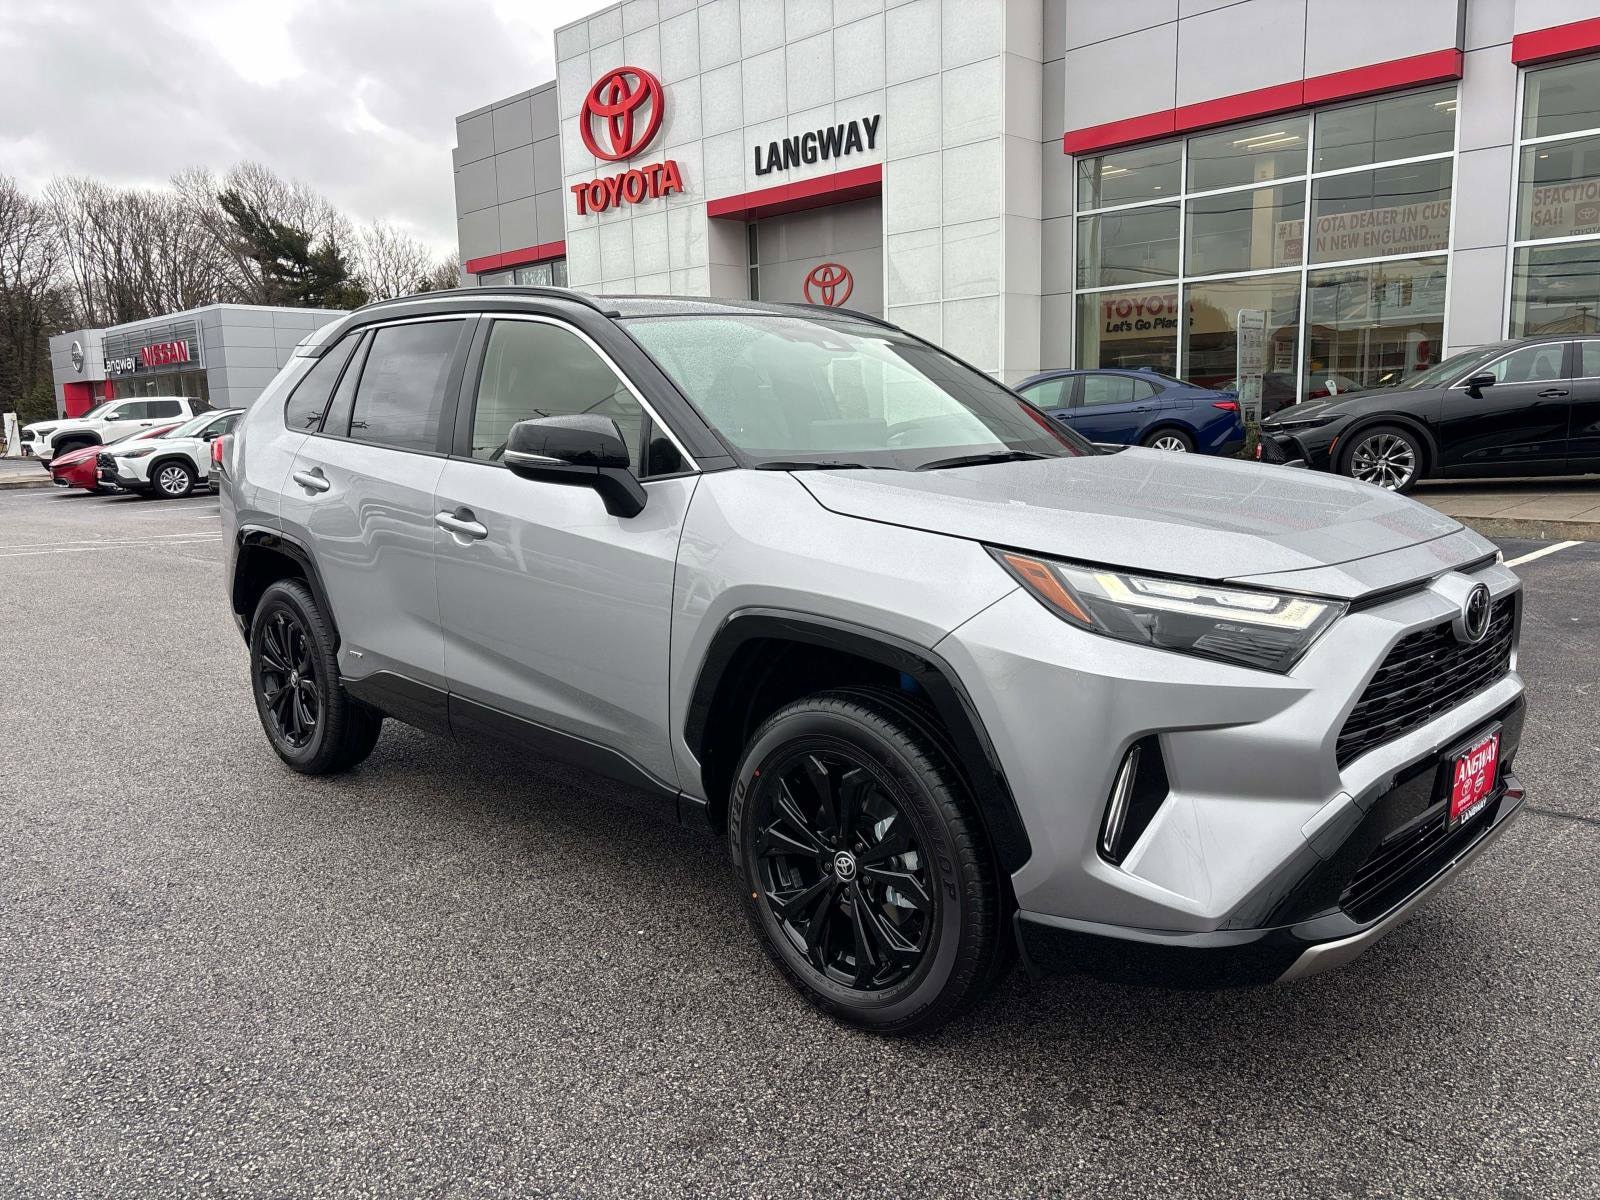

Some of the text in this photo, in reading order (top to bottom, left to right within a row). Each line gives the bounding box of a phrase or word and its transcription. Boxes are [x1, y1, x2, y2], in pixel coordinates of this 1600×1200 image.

[754, 114, 881, 176] LANGWAY
[571, 159, 685, 216] TOYOTA
[1534, 182, 1600, 206] SFACTIO
[1350, 209, 1398, 229] DEALER
[1402, 206, 1418, 222] IN
[1531, 206, 1563, 227] SA!!
[1331, 232, 1360, 251] NEW
[1364, 225, 1441, 247] ENGLAND...
[1106, 317, 1194, 333] Let's Go Plac
[103, 339, 190, 375] Langway NISSAN
